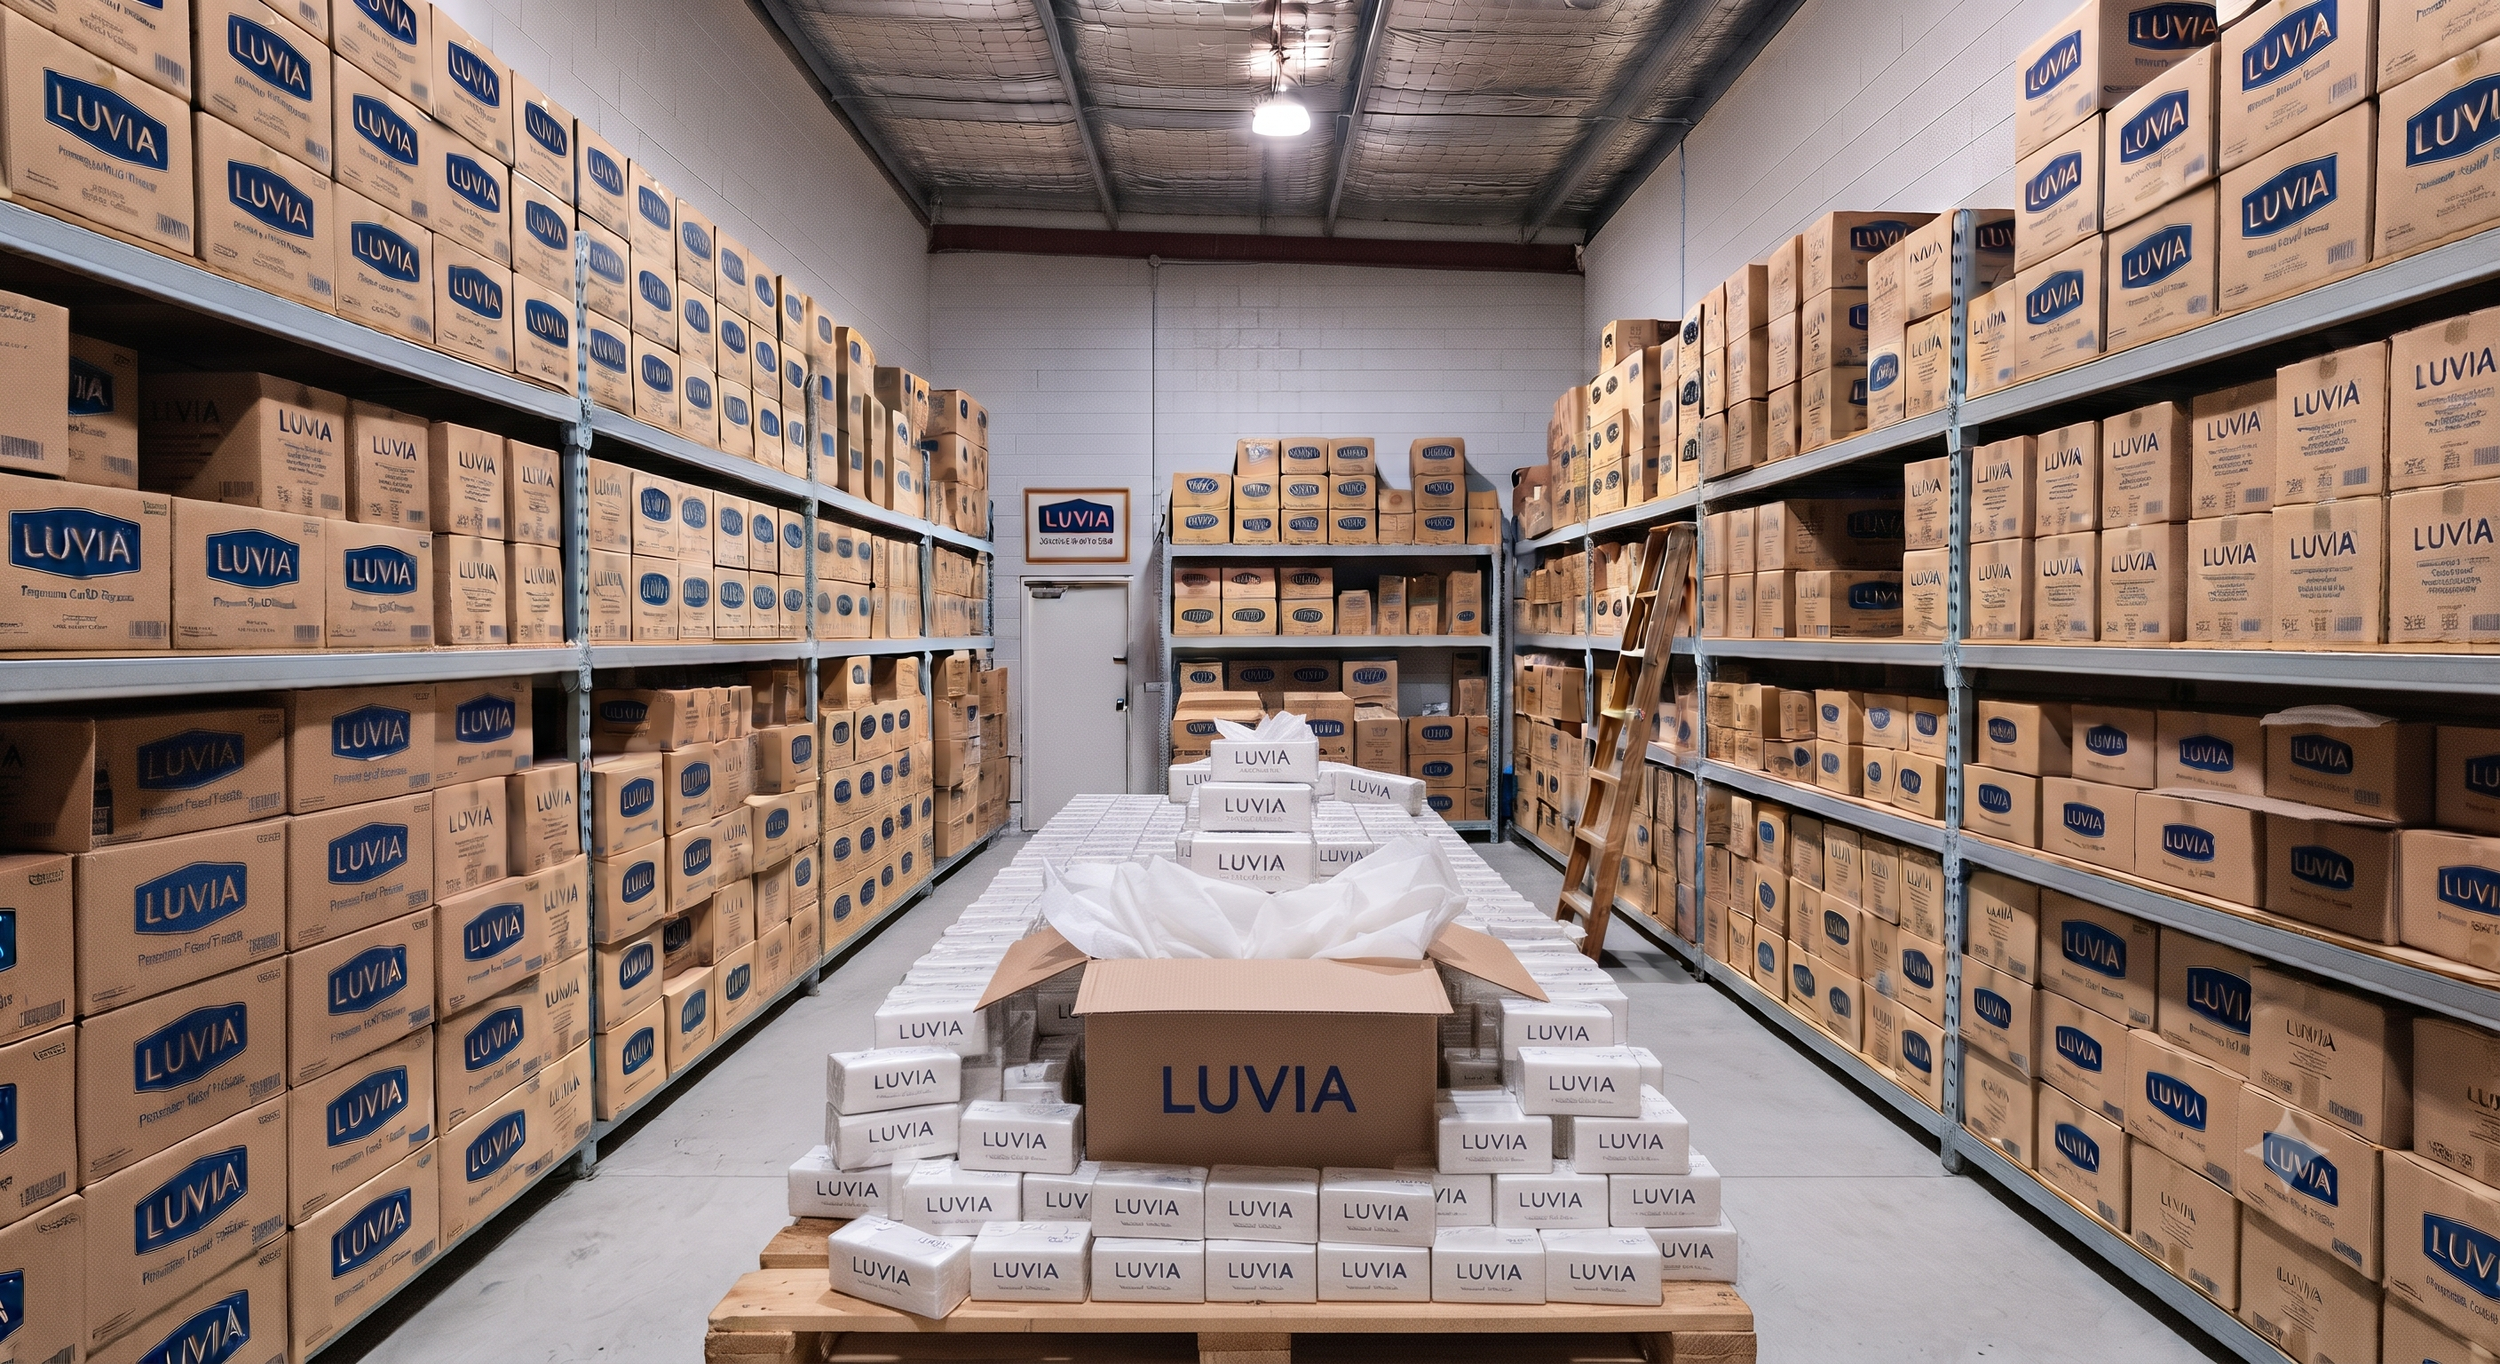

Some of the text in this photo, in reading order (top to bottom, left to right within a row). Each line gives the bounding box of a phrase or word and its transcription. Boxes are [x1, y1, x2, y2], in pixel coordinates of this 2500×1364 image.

[367, 0, 414, 40] UVIA
[2136, 15, 2217, 40] LUVIA
[235, 24, 306, 92] LUVIA
[2248, 12, 2331, 81] LUVIA
[2030, 43, 2078, 91] LUVIA
[56, 81, 158, 162] LUVIA
[358, 107, 414, 159] LUVIA
[2125, 101, 2185, 156] LUVIA
[2415, 88, 2500, 155] LUVI
[450, 161, 498, 206] LUVIA
[2031, 161, 2078, 205] LUVIA
[235, 170, 308, 230] LUVIA
[2247, 169, 2329, 228] LUVIA
[528, 209, 565, 244] LUVIA
[1980, 227, 2015, 247] LUV
[357, 232, 416, 278] LUVIA
[2127, 235, 2187, 280] LUVIA
[453, 275, 501, 314] LUVIA
[2030, 279, 2080, 318] LUVIA
[2415, 347, 2497, 390] LUVIA
[2293, 380, 2360, 417] LUVIA
[279, 409, 332, 442] LUVIA
[2207, 411, 2261, 441] LUVIA
[372, 435, 417, 462] LUVIA
[2112, 432, 2159, 458] LUVIA
[459, 451, 496, 476] LUVIA
[2045, 447, 2082, 472] LUVIA
[1046, 510, 1109, 528] LUVIA
[23, 523, 131, 564] LUVIA
[2291, 531, 2357, 560] LUVIA
[2414, 518, 2494, 551] LUVIA
[217, 542, 292, 578] LUVIA
[2043, 557, 2083, 577] LUVIA
[2111, 552, 2157, 573] LUVIA
[2203, 543, 2256, 567] LUVIA
[352, 558, 411, 586] LUVIA
[461, 706, 512, 734] LUVIA
[340, 720, 404, 750] LUVIA
[147, 741, 237, 779] LUVIA
[1235, 750, 1291, 766] LUVIA
[2182, 744, 2230, 765] LUVIA
[2294, 740, 2348, 768] LUVIA
[1186, 774, 1211, 786] LUV
[1350, 779, 1391, 800] LUVIA
[536, 789, 571, 813] LUVIA
[1225, 797, 1286, 813] LUVIA
[449, 805, 493, 834] LUVIA
[2067, 812, 2102, 830] LUVIA
[336, 835, 403, 874] LUVIA
[2166, 832, 2210, 854] LUVIA
[1218, 854, 1285, 872] LUVIA
[2294, 855, 2348, 882] LUVIA
[145, 875, 239, 924] LUVIA
[2444, 875, 2500, 908] LUVI
[469, 914, 521, 952] LUVIA
[2065, 931, 2120, 970] LUVIA
[336, 957, 402, 1005] LUVIA
[470, 1018, 518, 1062] LUVIA
[899, 1020, 963, 1040] LUVIA
[1527, 1025, 1589, 1042] LUVIA
[144, 1018, 238, 1082] LUVIA
[874, 1069, 936, 1090] LUVIA
[1163, 1066, 1357, 1114] LUVIA
[1549, 1075, 1615, 1092] LUVIA
[334, 1078, 402, 1136] LUVIA
[869, 1121, 934, 1143] LUVIA
[983, 1132, 1047, 1149] LUVIA
[1462, 1134, 1527, 1150] LUVIA
[1599, 1133, 1664, 1150] LUVIA
[471, 1121, 522, 1173] LUVIA
[2270, 1141, 2331, 1197] LUVIA
[146, 1162, 240, 1240] LUVIA
[817, 1181, 879, 1198] LUVIA
[1046, 1192, 1088, 1209] LUV
[1436, 1188, 1467, 1204] VIA
[1519, 1192, 1583, 1208] LUVIA
[1633, 1188, 1696, 1204] LUVIA
[926, 1196, 993, 1213] LUVIA
[1115, 1199, 1179, 1216] LUVIA
[1229, 1200, 1293, 1218] LUVIA
[1344, 1203, 1409, 1222] LUVIA
[338, 1201, 406, 1267] LUVIA
[1661, 1243, 1714, 1259] UVIA
[2432, 1224, 2500, 1279] LUV
[853, 1255, 911, 1287] LUVIA
[993, 1262, 1059, 1279] LUVIA
[1115, 1262, 1181, 1279] LUVIA
[1229, 1263, 1294, 1279] LUVIA
[1342, 1262, 1408, 1279] LUVIA
[1456, 1263, 1522, 1281] LUVIA
[1570, 1263, 1636, 1282] LUVIA
